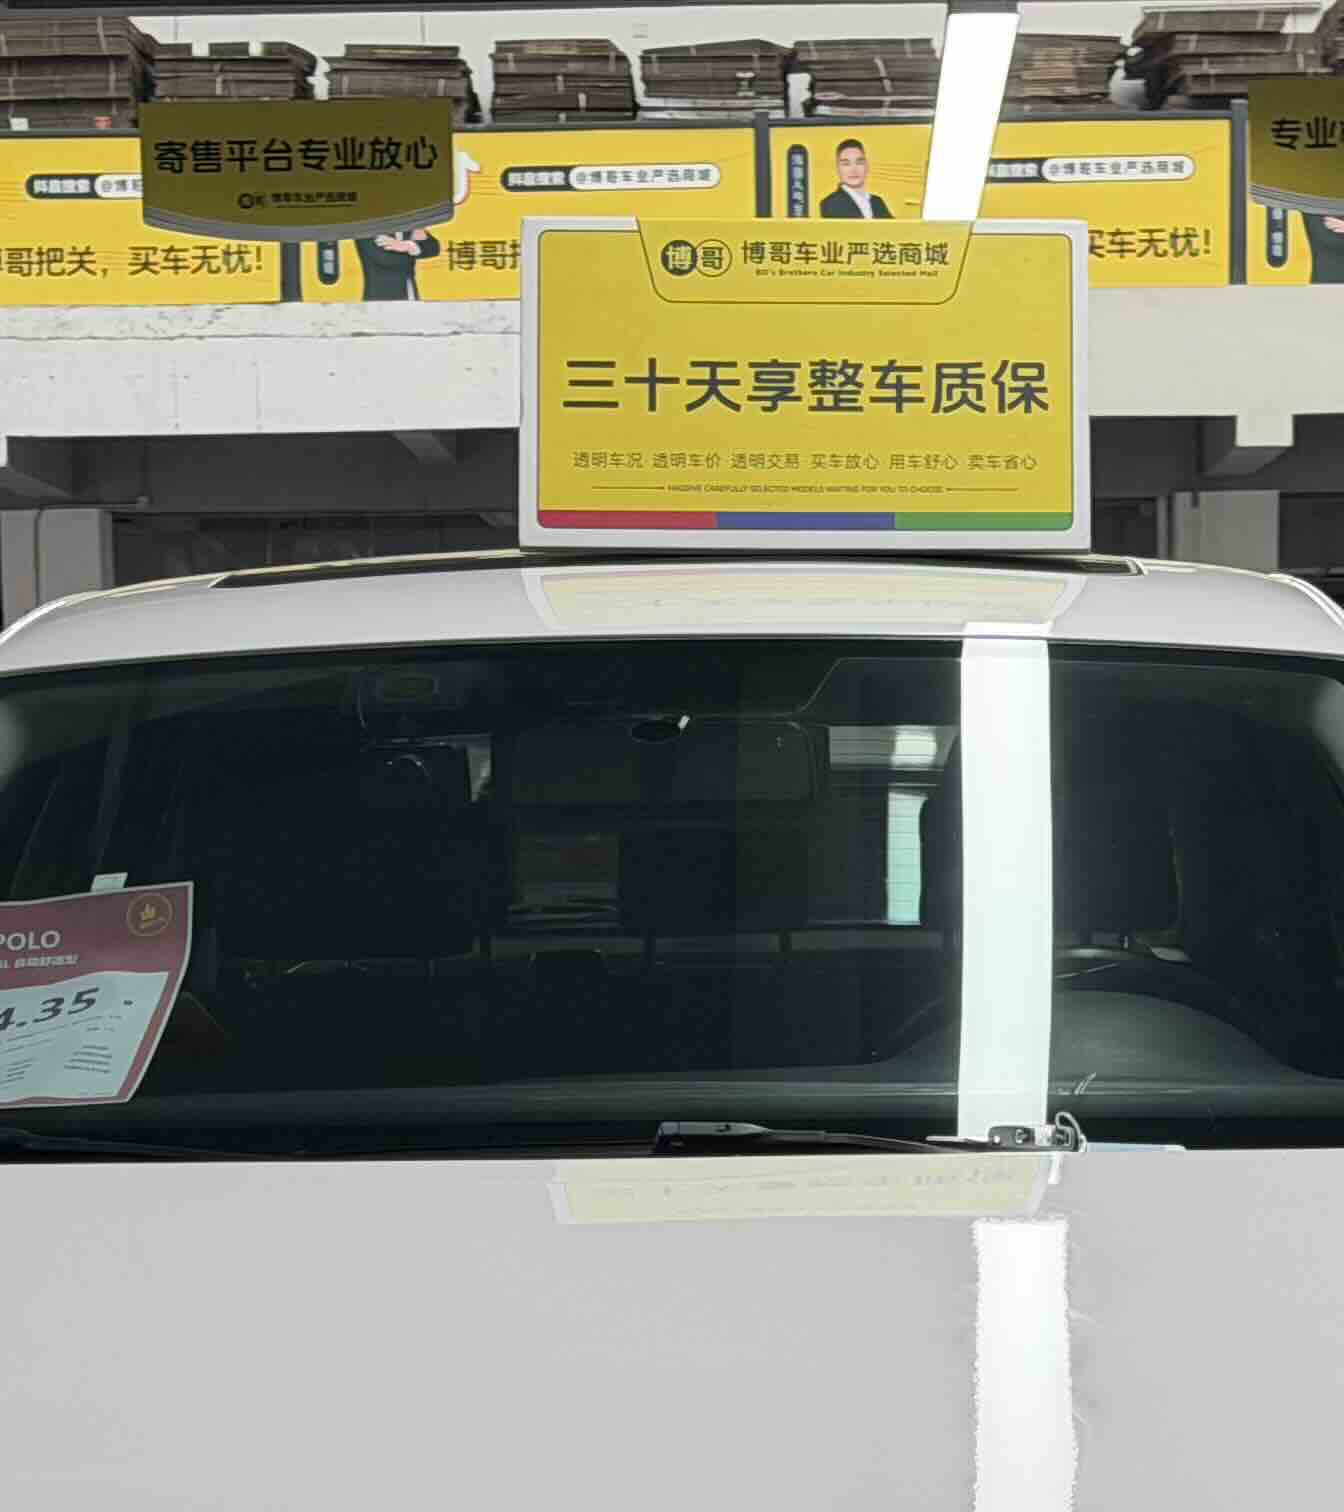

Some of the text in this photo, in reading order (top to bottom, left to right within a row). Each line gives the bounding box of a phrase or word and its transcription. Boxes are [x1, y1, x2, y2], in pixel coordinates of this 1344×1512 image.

[153, 137, 438, 174] 寄售平台专业放心
[663, 240, 949, 274] 博哥 博哥车业严选商城
[561, 357, 1050, 414] 三十天享整车质保
